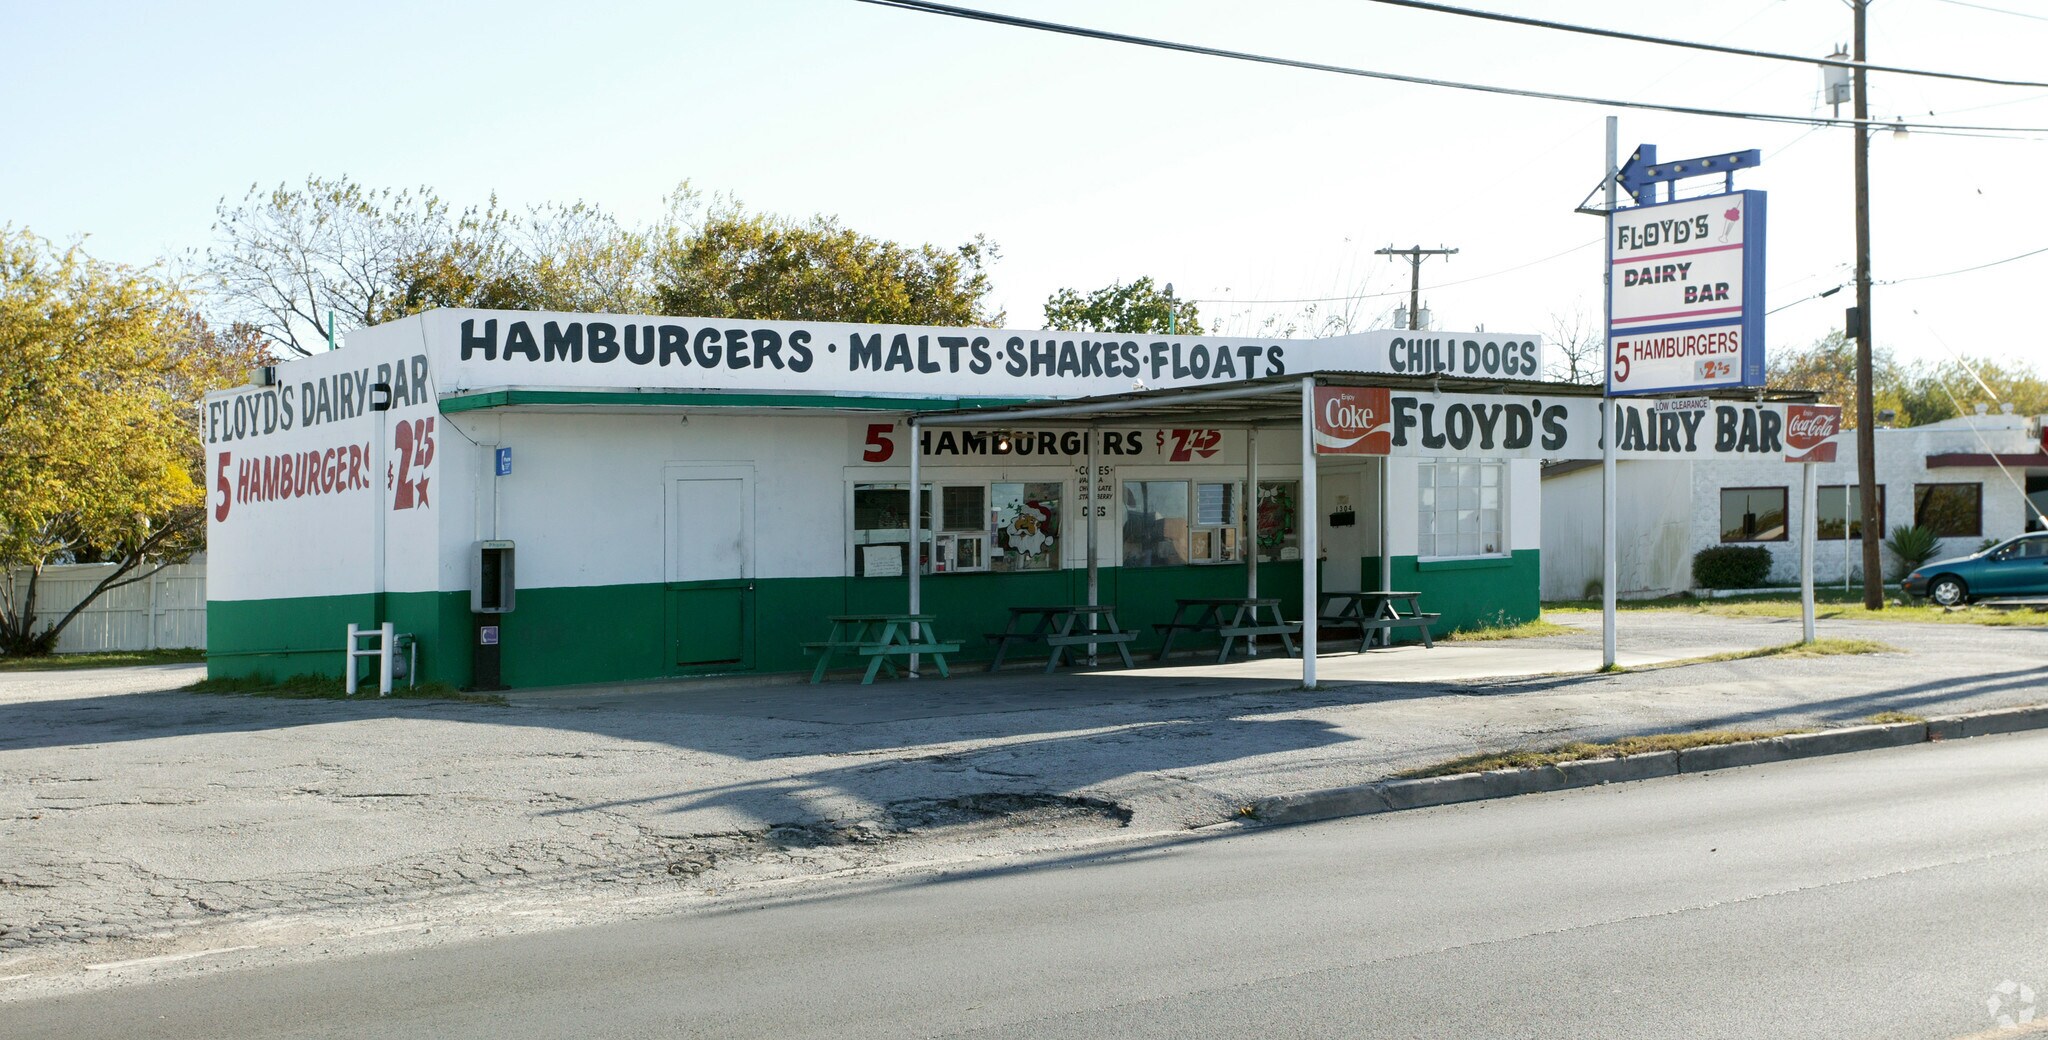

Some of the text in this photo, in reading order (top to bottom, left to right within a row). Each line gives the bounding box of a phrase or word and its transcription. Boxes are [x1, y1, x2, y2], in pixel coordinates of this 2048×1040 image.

[1617, 213, 1709, 250] FLOYD'S
[1624, 261, 1692, 287] DAIRY
[1684, 282, 1730, 305] BAR
[461, 318, 1285, 380] HAMBURGERS MALTS SHAKES FLOATS
[1389, 337, 1538, 376] CHILI DOGS
[1614, 331, 1738, 383] 5 HAMBURGERS
[208, 354, 429, 444] FLOYD'S DAIRY BAR
[1325, 397, 1374, 429] Coke
[1655, 399, 1708, 411] LOW CLEARANCE
[862, 423, 894, 463] 5
[1391, 397, 1568, 451] FLOYD'S
[1714, 405, 1782, 453] BAR
[1788, 414, 1837, 437] Coca-Cola
[215, 451, 232, 523] 5
[1079, 465, 1110, 475] CES
[1082, 506, 1106, 517] CES
